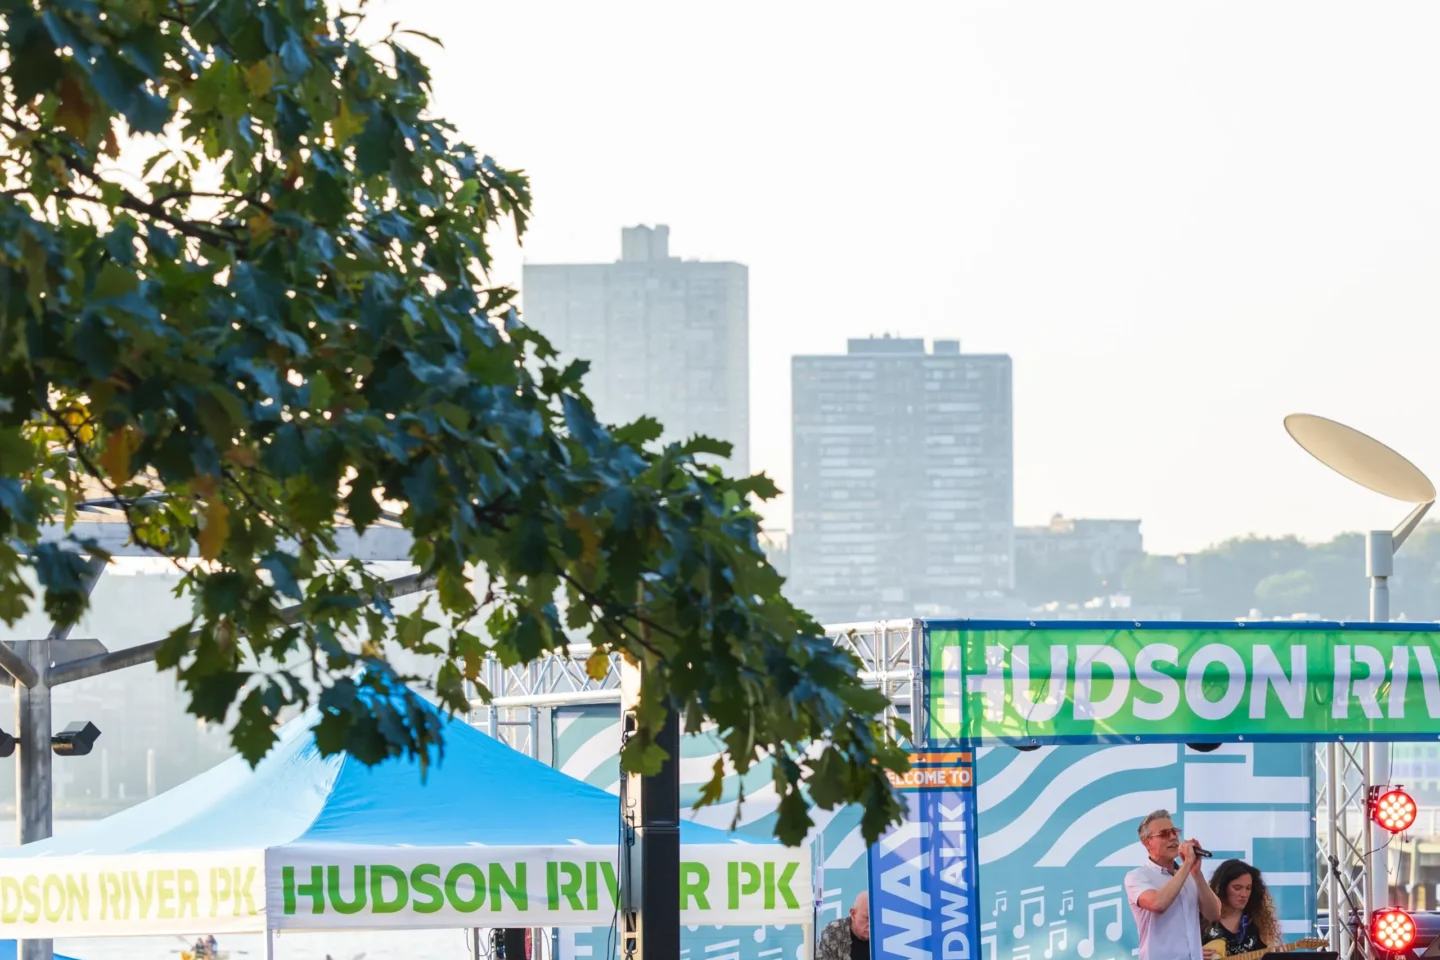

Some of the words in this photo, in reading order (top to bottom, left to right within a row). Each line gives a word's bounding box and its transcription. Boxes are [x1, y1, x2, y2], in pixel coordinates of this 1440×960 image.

[943, 643, 1308, 723] HUDSON
[886, 770, 946, 785] ELCOME
[949, 770, 970, 784] TO
[0, 873, 90, 924] DSON
[99, 869, 200, 921] RIVER
[209, 867, 258, 917] PK
[282, 862, 529, 915] HUDSON
[728, 861, 801, 910] PK
